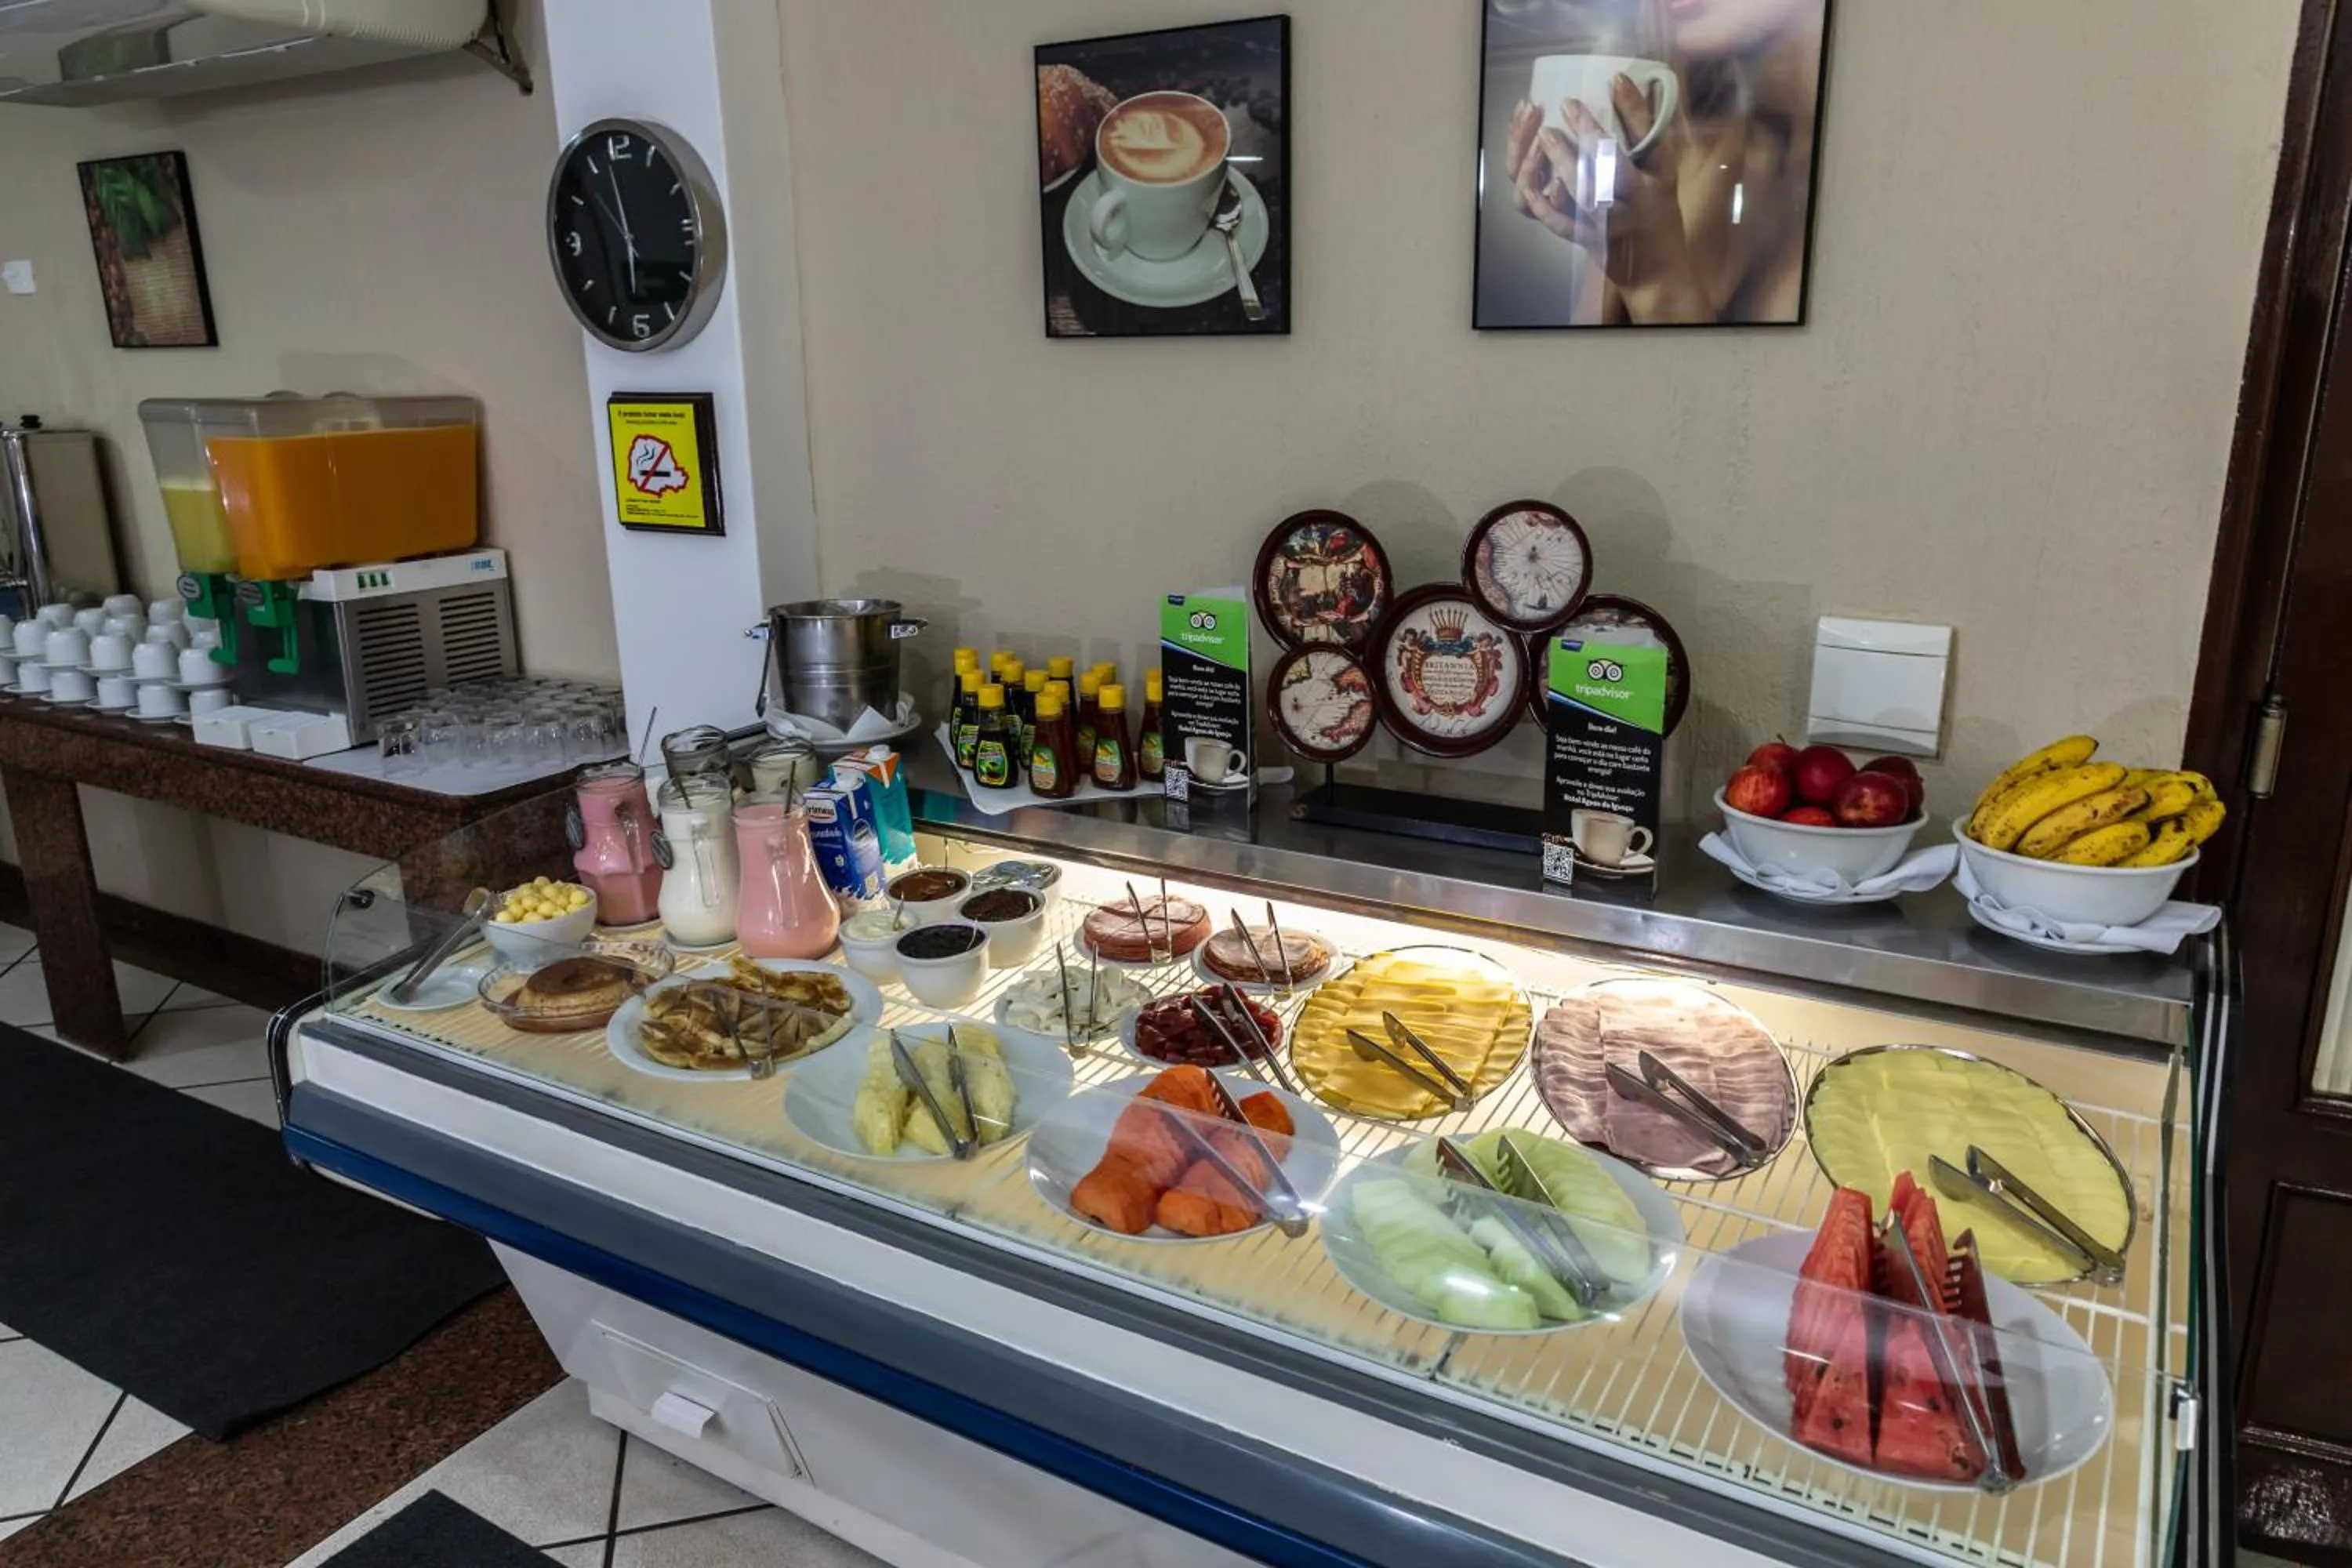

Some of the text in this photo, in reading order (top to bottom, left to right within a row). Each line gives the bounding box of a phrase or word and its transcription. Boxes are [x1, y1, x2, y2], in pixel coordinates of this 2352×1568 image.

[608, 136, 632, 160] 12
[633, 314, 650, 338] 6
[1575, 683, 1629, 699] tripadvisor
[808, 806, 834, 815] rimesa
